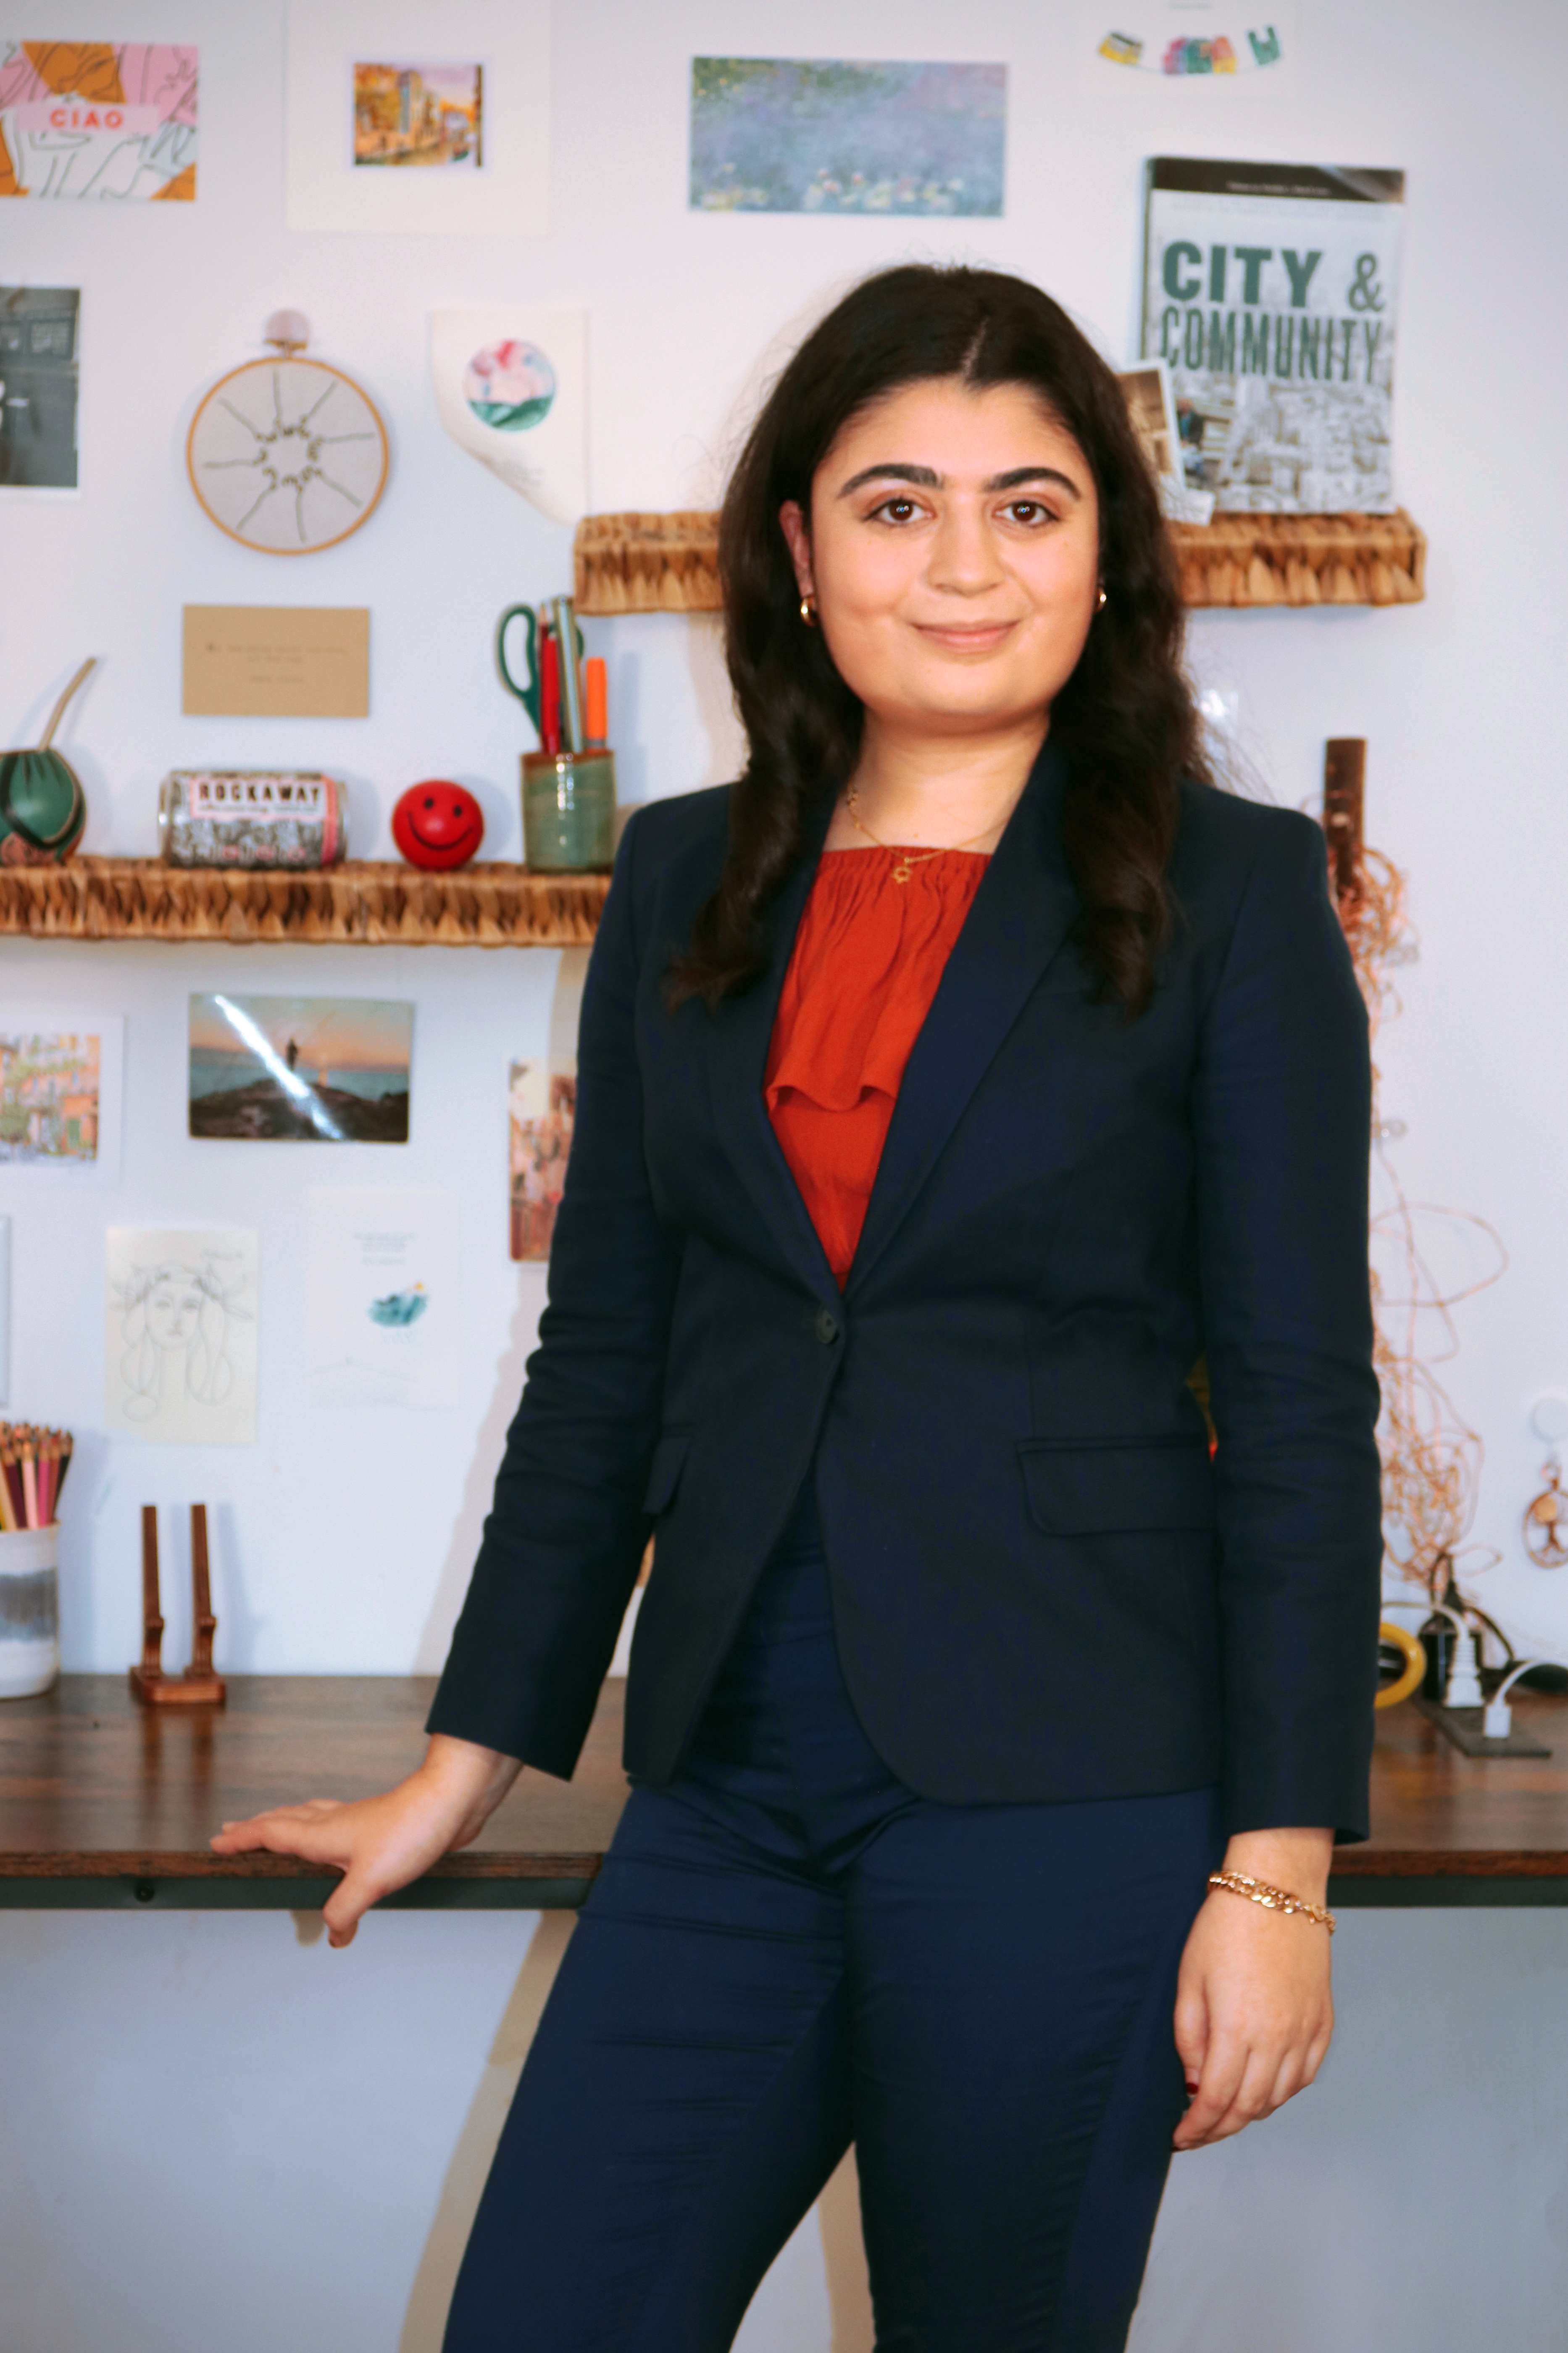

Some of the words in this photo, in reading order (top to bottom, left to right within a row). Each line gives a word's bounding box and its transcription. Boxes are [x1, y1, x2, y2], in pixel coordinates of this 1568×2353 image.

[49, 108, 124, 129] CIAO
[1162, 240, 1323, 308] CITY
[1347, 251, 1384, 312] &
[1160, 306, 1383, 383] COMMUNITY
[200, 783, 319, 804] ROCKAWAY
